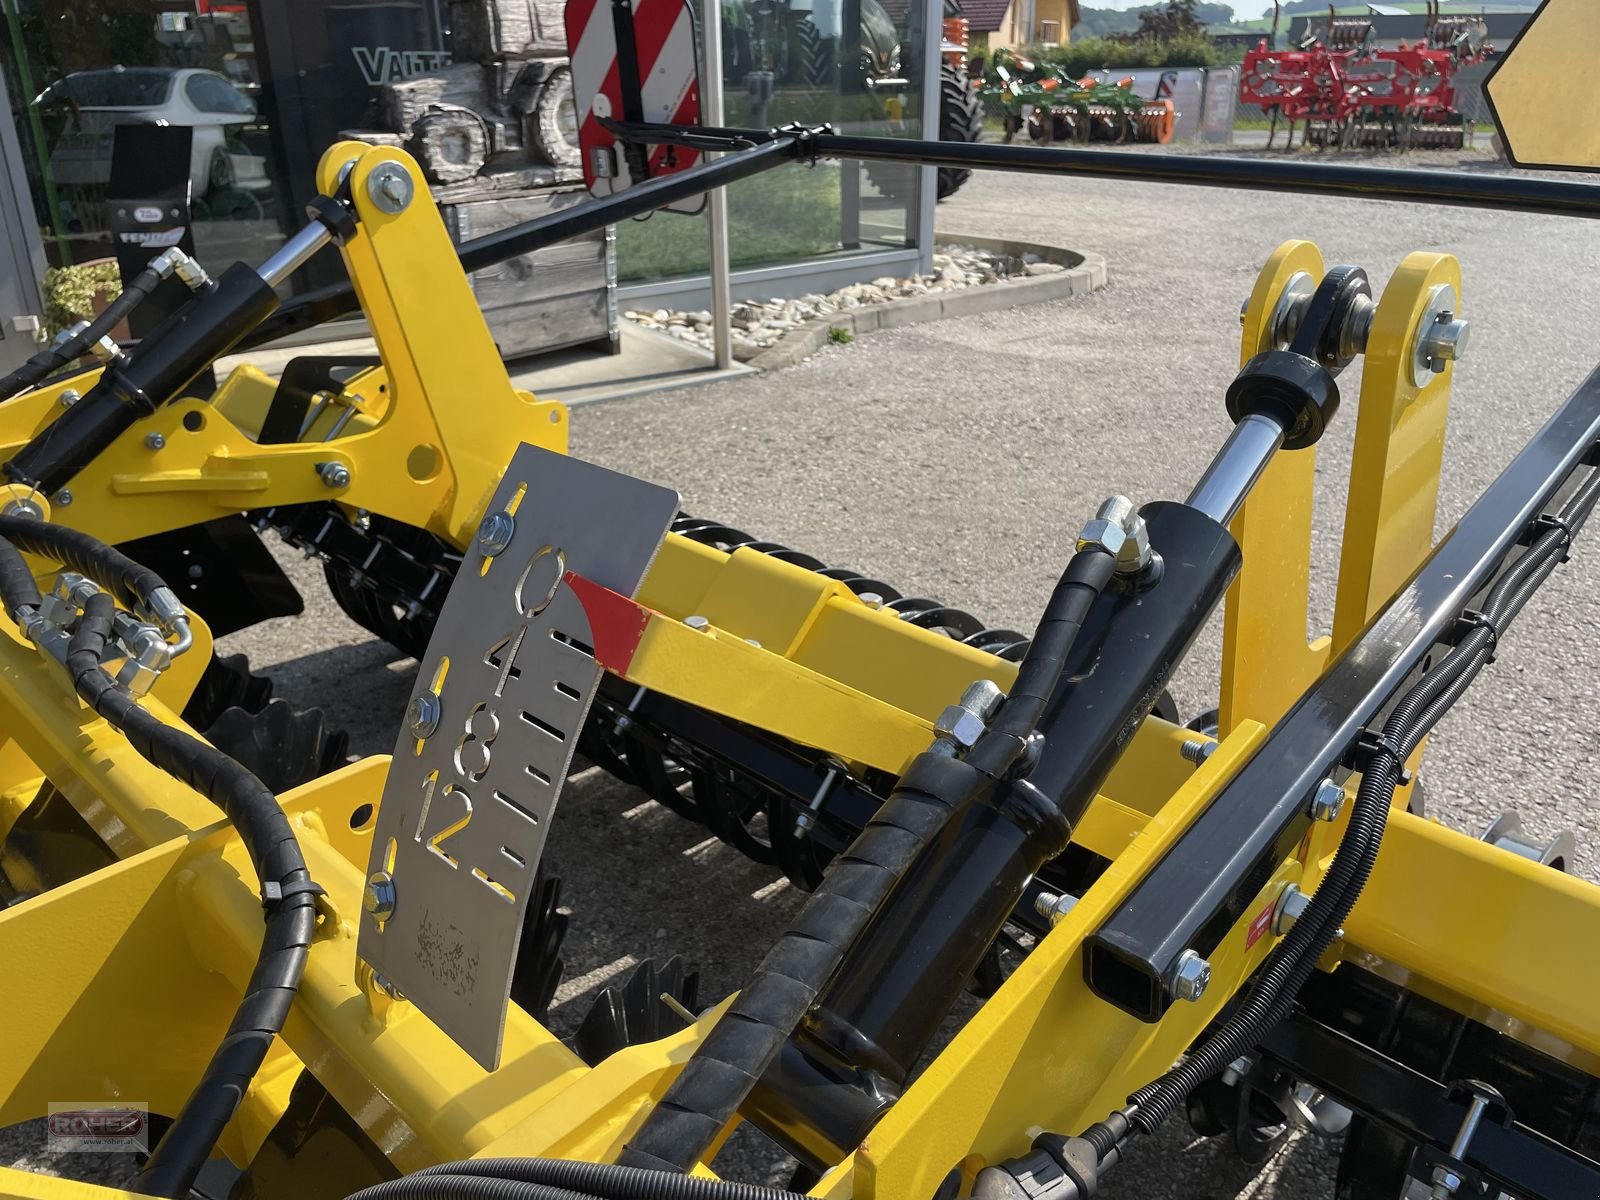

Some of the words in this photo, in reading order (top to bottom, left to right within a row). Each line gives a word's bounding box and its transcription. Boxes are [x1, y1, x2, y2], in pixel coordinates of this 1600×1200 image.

[514, 545, 567, 619] 0
[483, 623, 528, 697] 4
[453, 702, 500, 783] 8
[414, 768, 474, 870] 12
